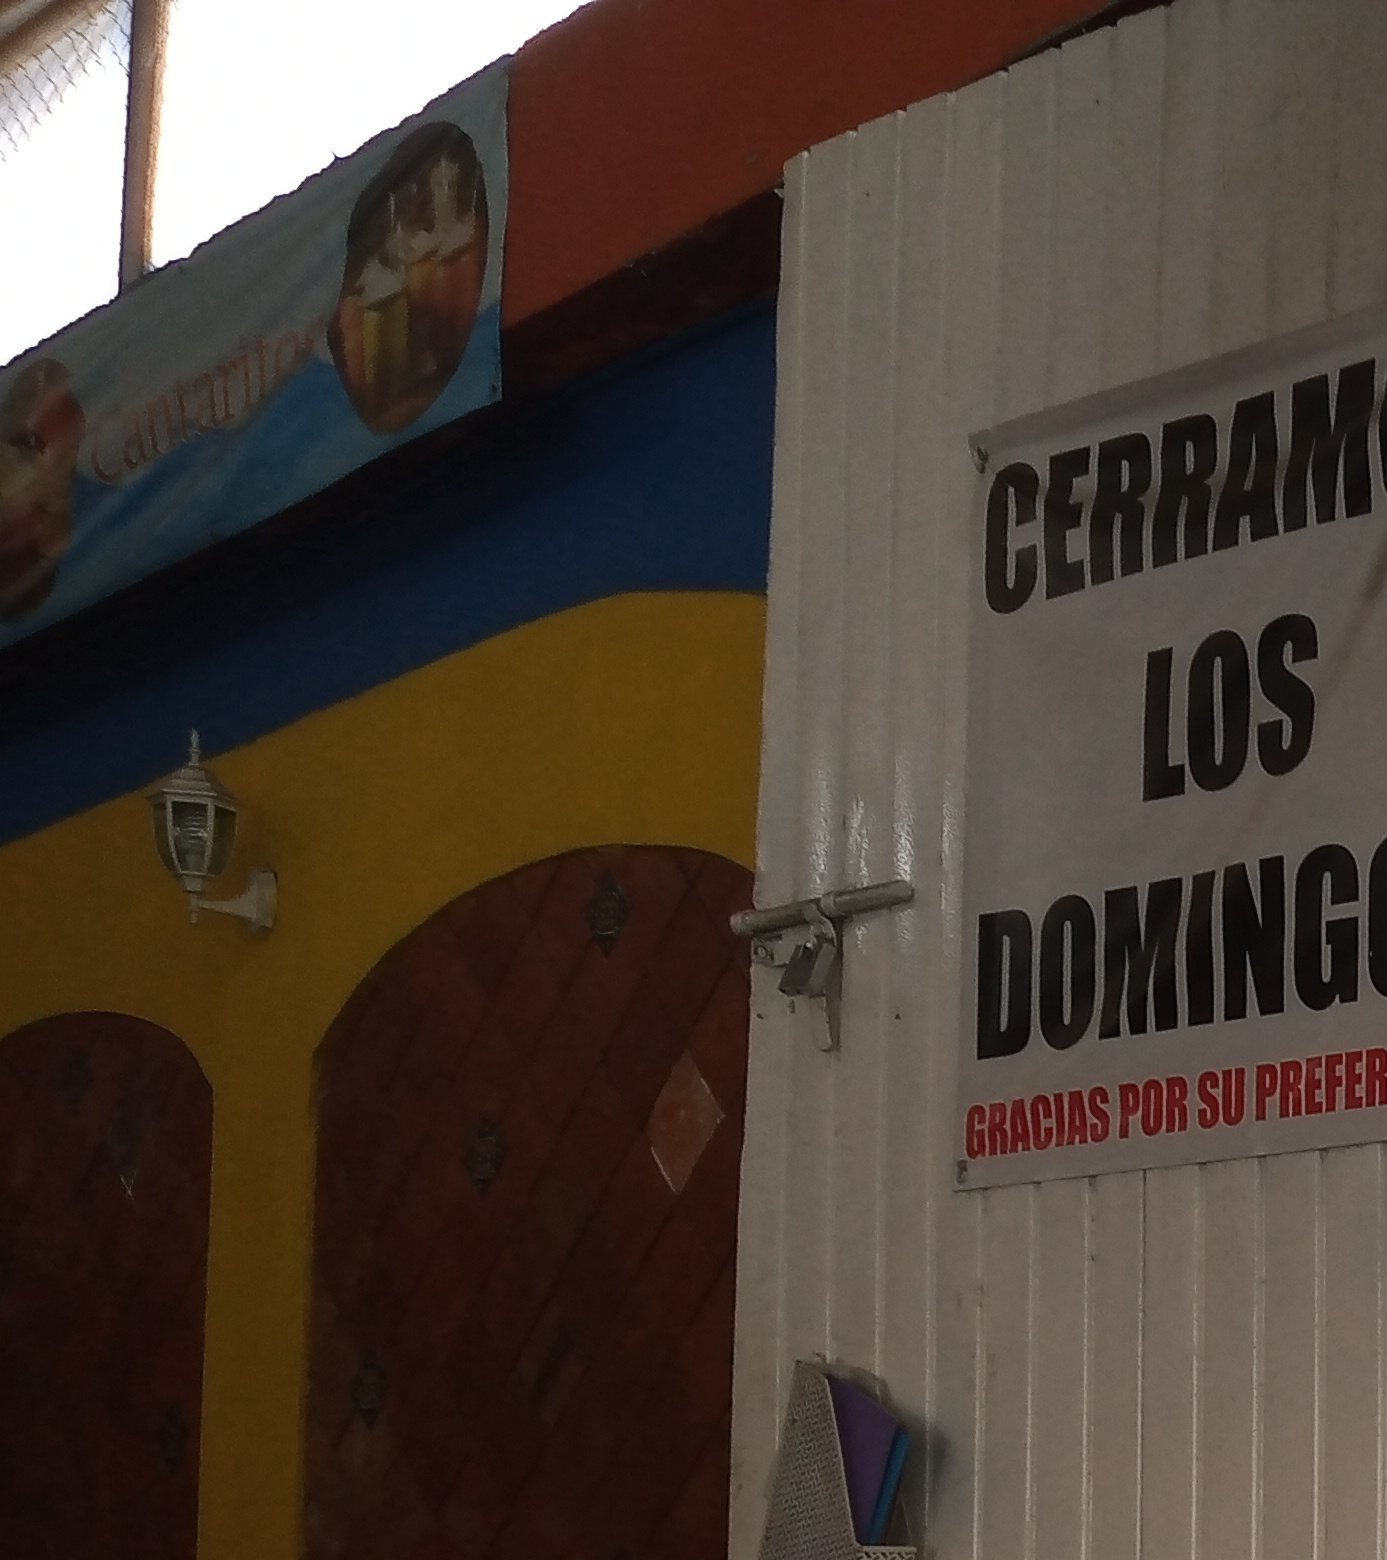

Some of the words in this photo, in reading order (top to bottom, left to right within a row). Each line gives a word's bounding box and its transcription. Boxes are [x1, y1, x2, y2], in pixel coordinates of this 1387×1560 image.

[1141, 613, 1319, 802] LOS
[964, 1086, 1110, 1160] GRACIAS
[1117, 1075, 1188, 1141] POR
[1196, 1067, 1247, 1129] SU
